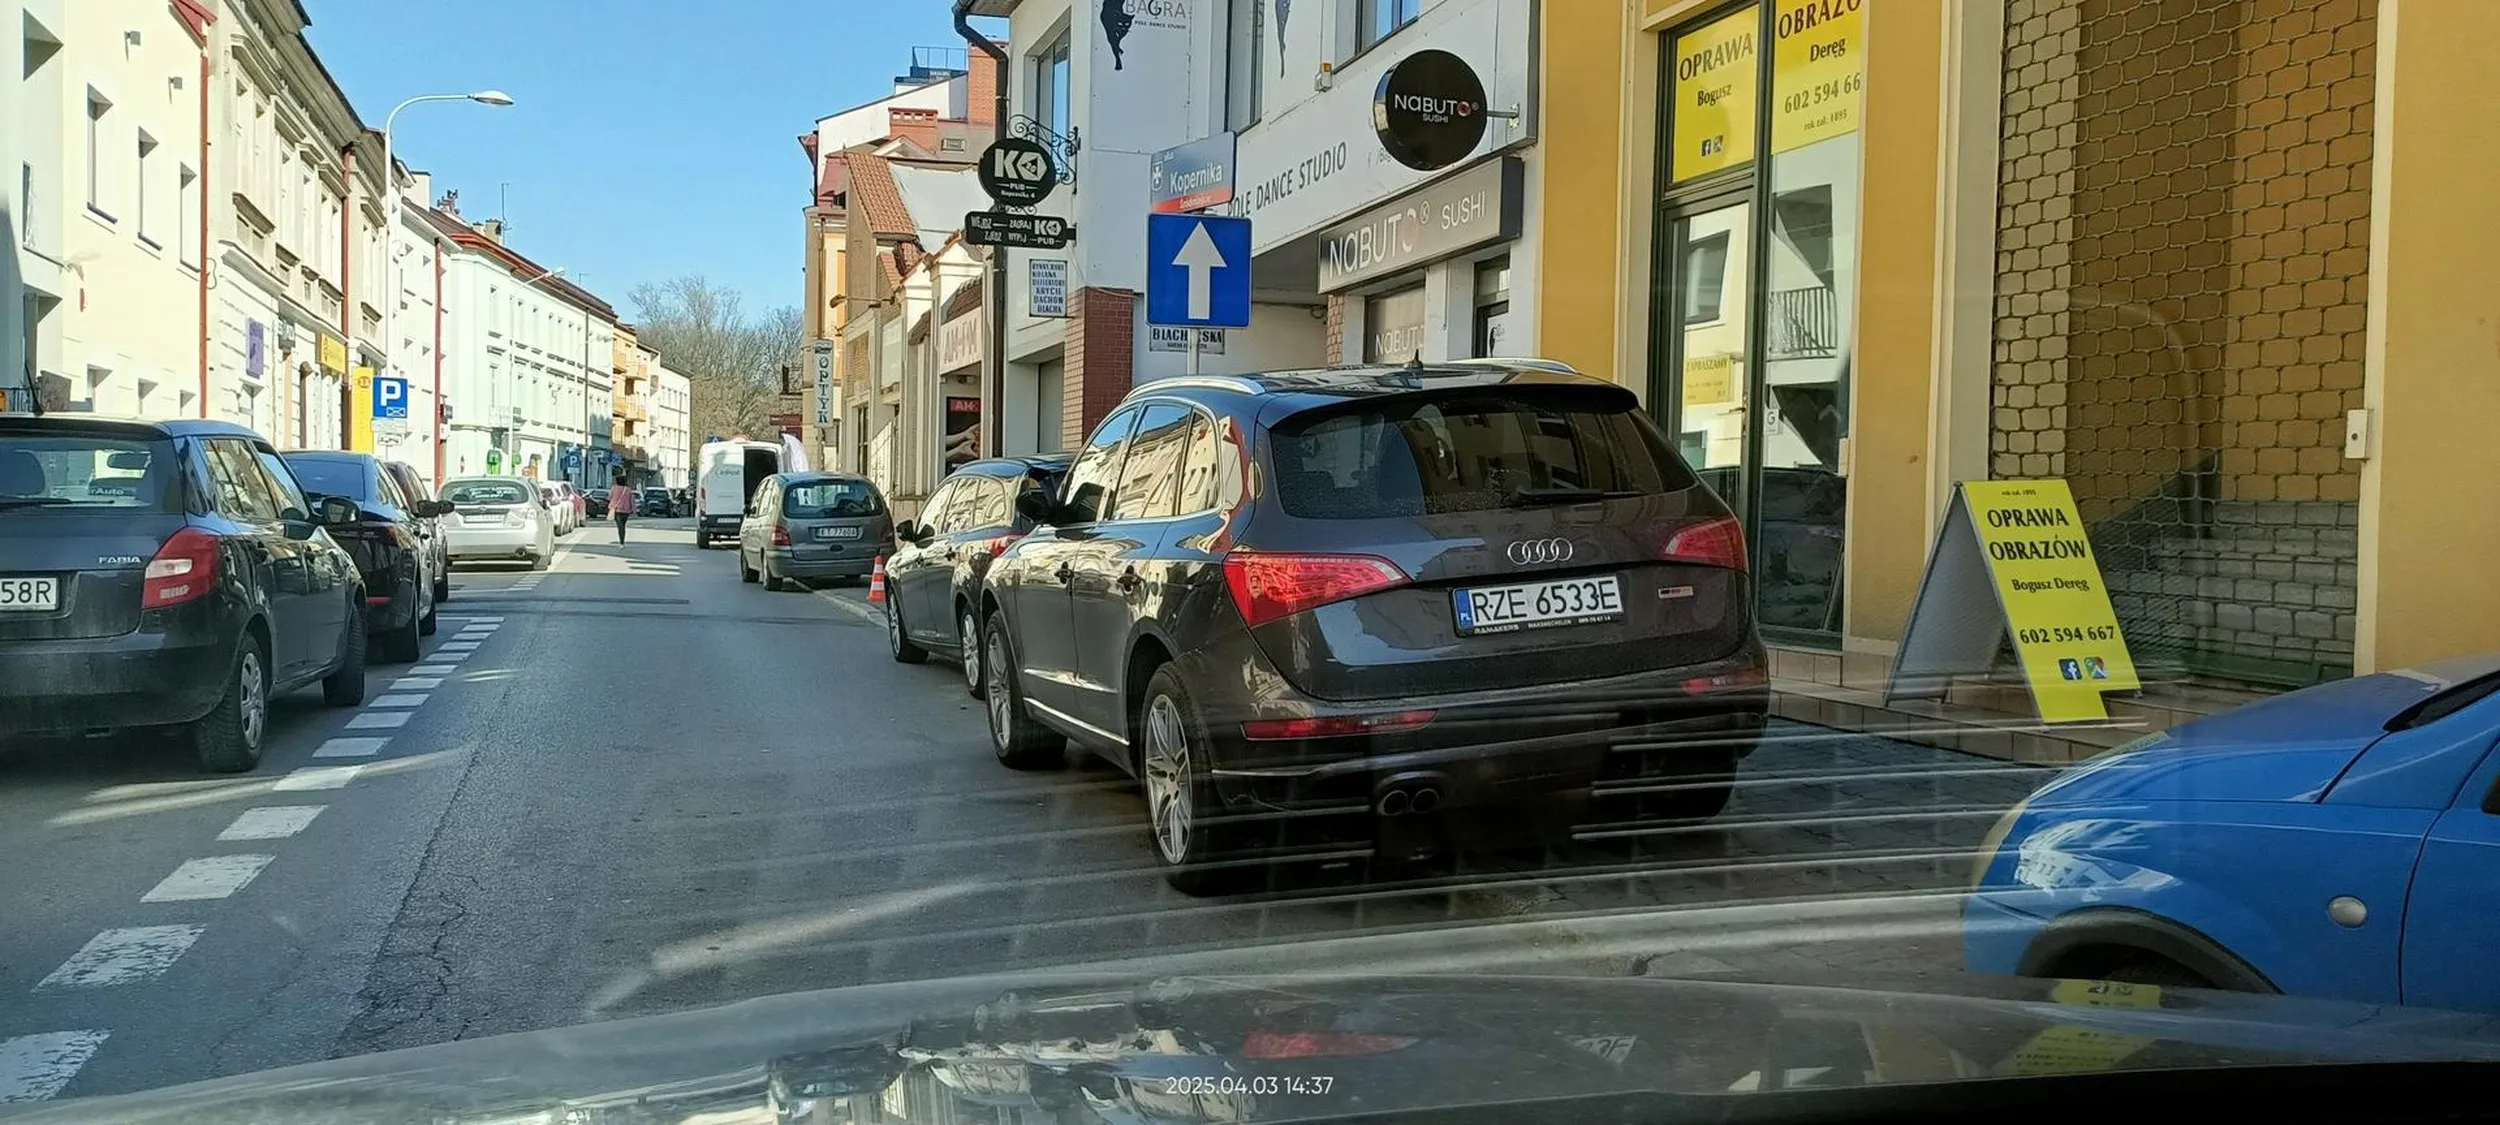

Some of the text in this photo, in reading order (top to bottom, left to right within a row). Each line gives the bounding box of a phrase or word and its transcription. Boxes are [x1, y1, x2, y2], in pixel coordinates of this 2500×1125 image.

[1679, 32, 1753, 82] OPRAWA
[1810, 38, 1846, 62] Deręg
[1697, 84, 1732, 107] Bogusz
[1785, 90, 1809, 113] 602
[1813, 80, 1839, 105] 594
[1422, 113, 1448, 123] SUSHI
[1830, 109, 1847, 123] 1895
[1009, 182, 1026, 190] PUB
[1169, 161, 1222, 196] Kopernika
[1227, 141, 1347, 217] POLE DANCE STUDIO
[1441, 191, 1486, 230] SUSHI
[1038, 237, 1055, 245] PUB
[1152, 328, 1222, 343] BLACHSKA
[380, 380, 402, 407] P
[818, 356, 830, 423] OPTYK
[1767, 411, 1776, 425] G
[570, 455, 577, 464] P
[1987, 508, 2070, 528] OPRAWA
[1989, 534, 2086, 561] OBRAZÓW
[98, 556, 142, 564] FABIA
[2011, 578, 2053, 593] Bogusz
[1471, 579, 1618, 623] RZE 6533E
[1460, 612, 1471, 621] PL
[1474, 624, 1520, 634] RAMAKERS
[2020, 625, 2114, 644] 602 594 667
